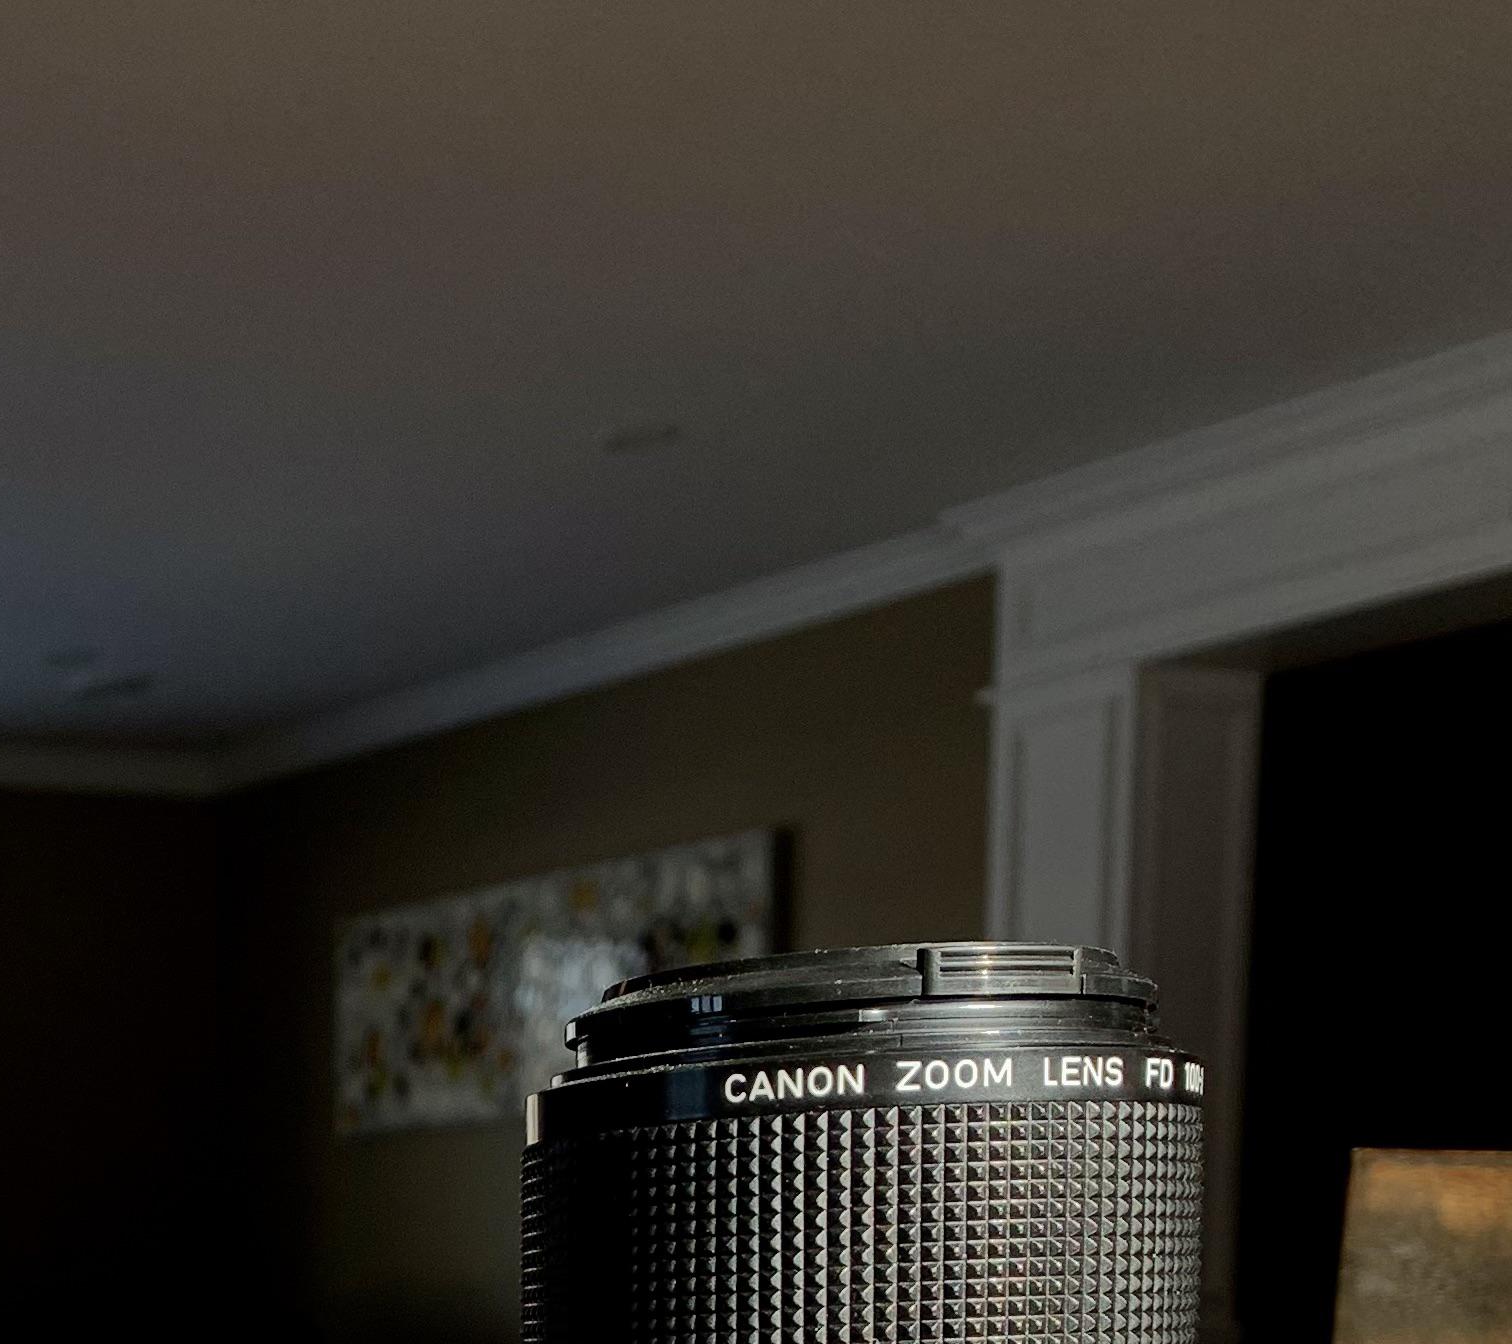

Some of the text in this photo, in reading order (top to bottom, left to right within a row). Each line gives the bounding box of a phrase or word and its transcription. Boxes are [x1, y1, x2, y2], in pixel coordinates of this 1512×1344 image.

[724, 1063, 866, 1104] CANON
[896, 1059, 1012, 1092] ZOOM
[1043, 1056, 1124, 1088] LENS
[1145, 1057, 1174, 1090] FD
